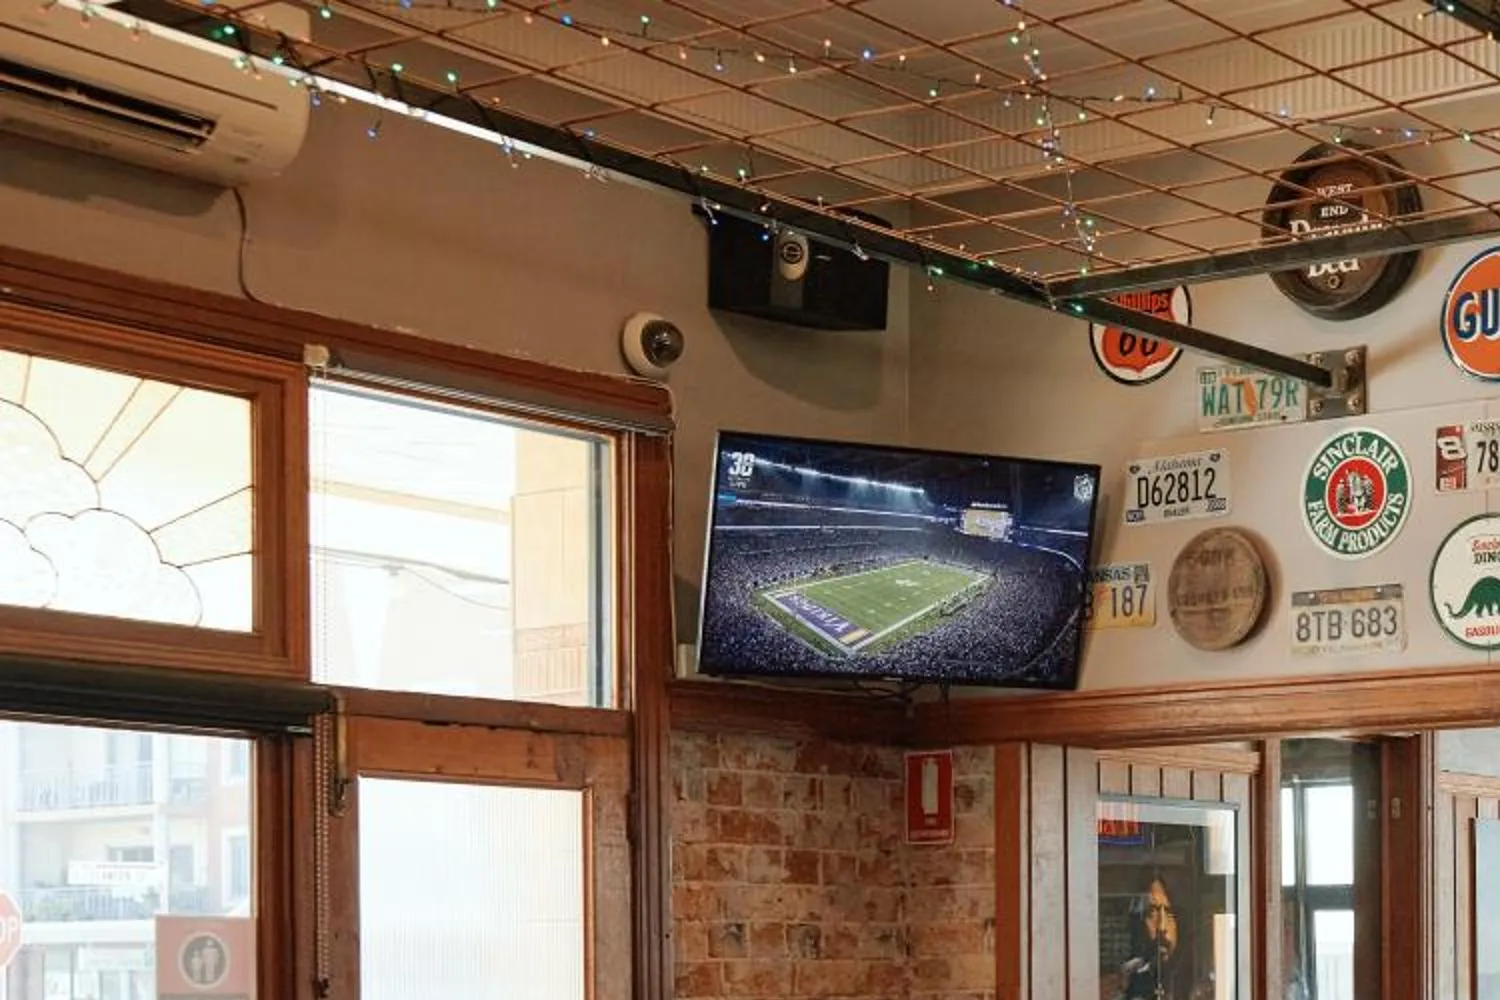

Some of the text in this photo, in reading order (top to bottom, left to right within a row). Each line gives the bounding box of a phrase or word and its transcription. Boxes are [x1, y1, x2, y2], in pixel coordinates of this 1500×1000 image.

[1321, 206, 1349, 218] END
[1313, 436, 1399, 480] SINCLAIR
[1137, 467, 1217, 509] D62812
[1308, 493, 1405, 552] FARM PRODUCTS
[1110, 583, 1149, 619] 187
